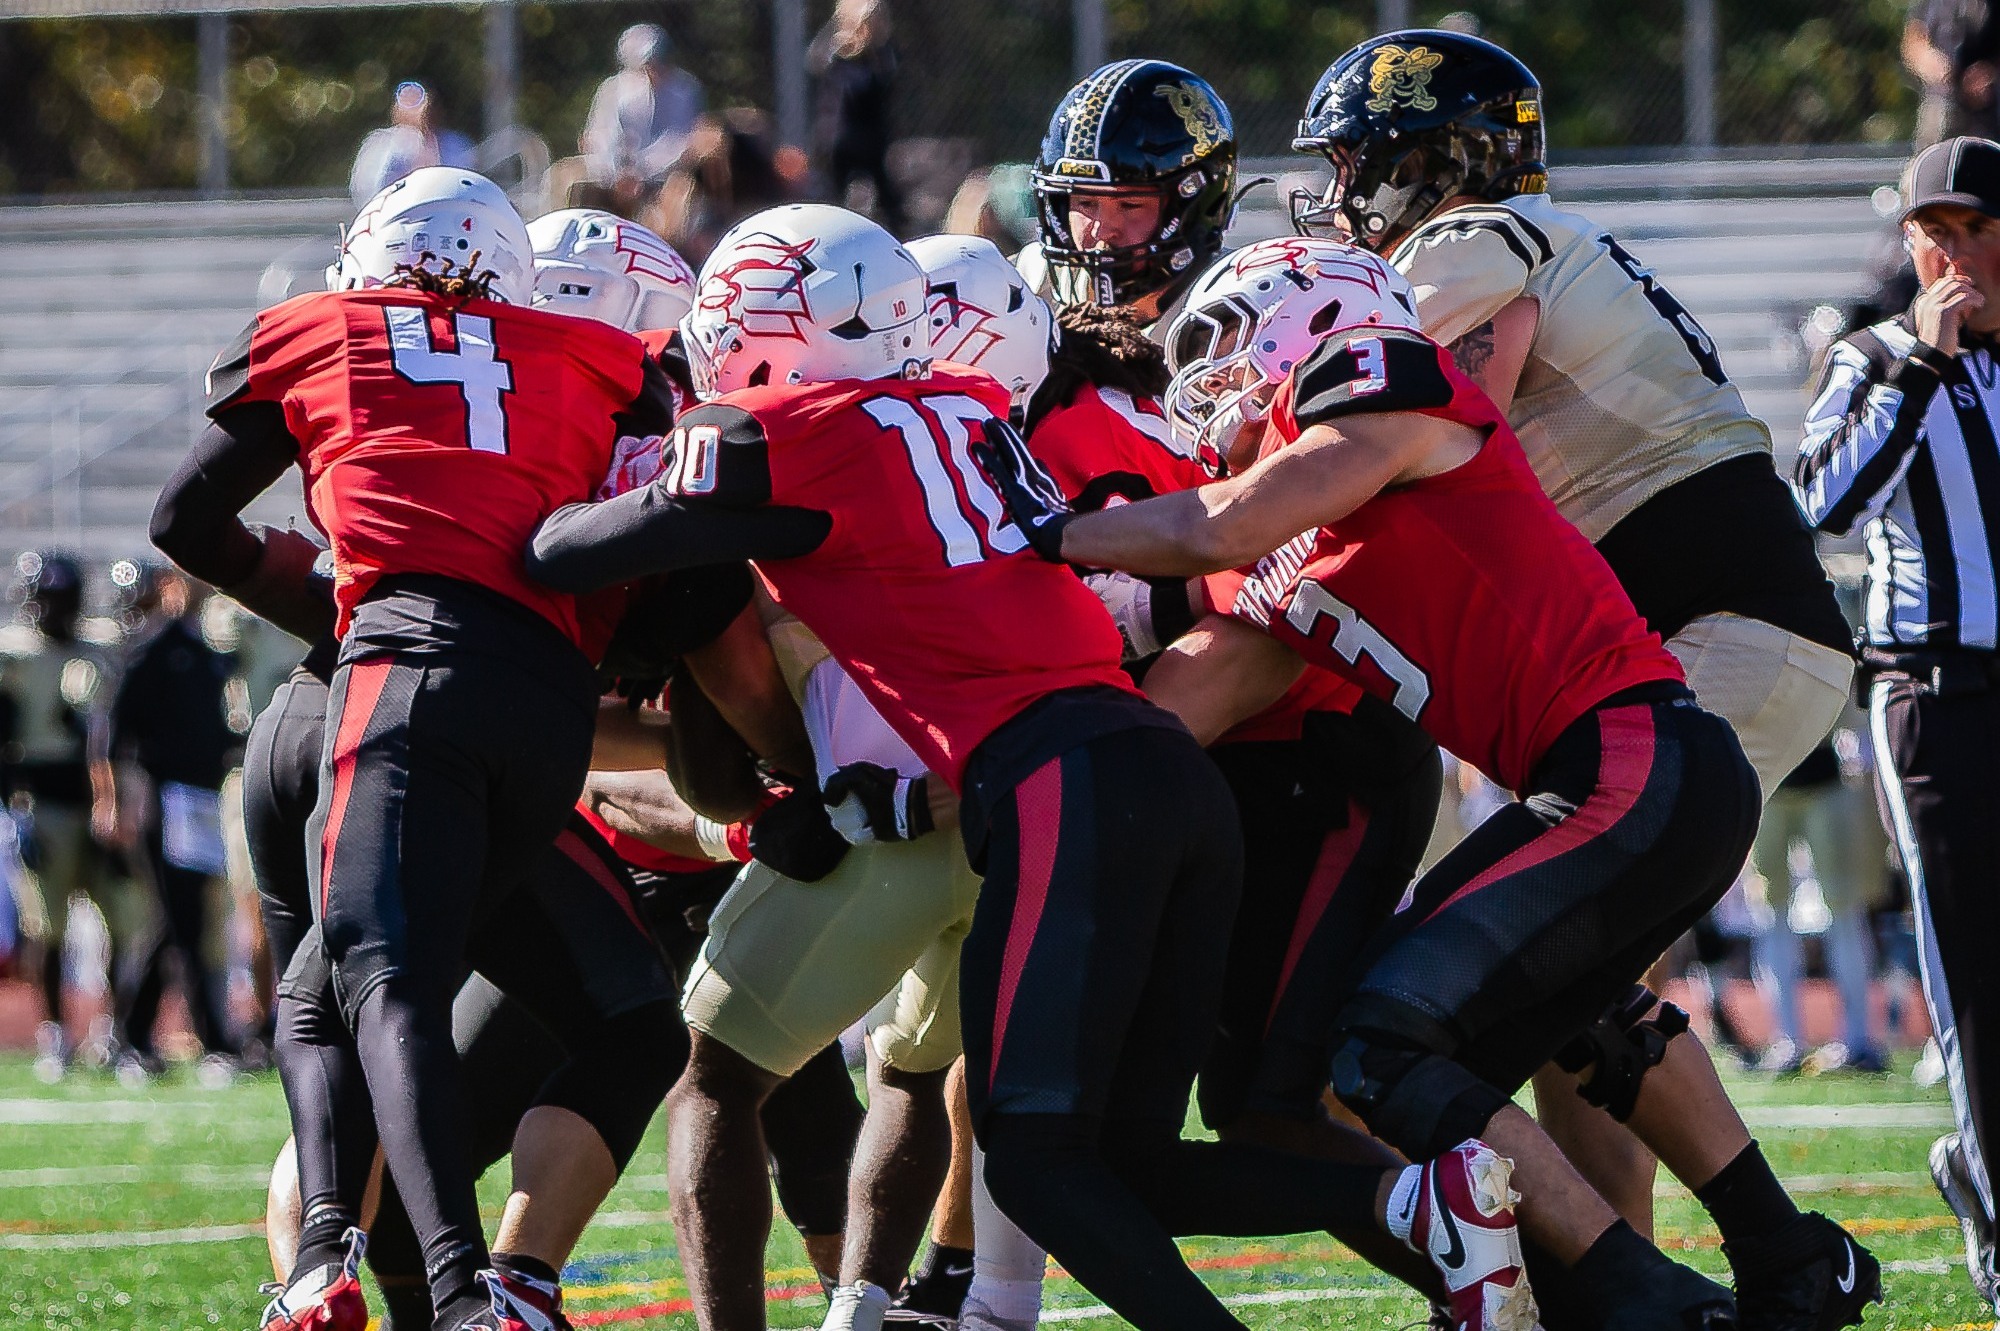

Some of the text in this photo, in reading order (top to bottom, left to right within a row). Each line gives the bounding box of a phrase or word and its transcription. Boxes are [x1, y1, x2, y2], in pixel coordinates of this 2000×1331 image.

[1061, 162, 1097, 176] WVSU
[461, 217, 473, 232] 4
[892, 299, 908, 318] 10
[382, 304, 516, 456] 4
[1347, 335, 1389, 398] 3
[1952, 383, 1977, 408] S
[664, 425, 723, 496] 10
[860, 394, 1030, 568] 10
